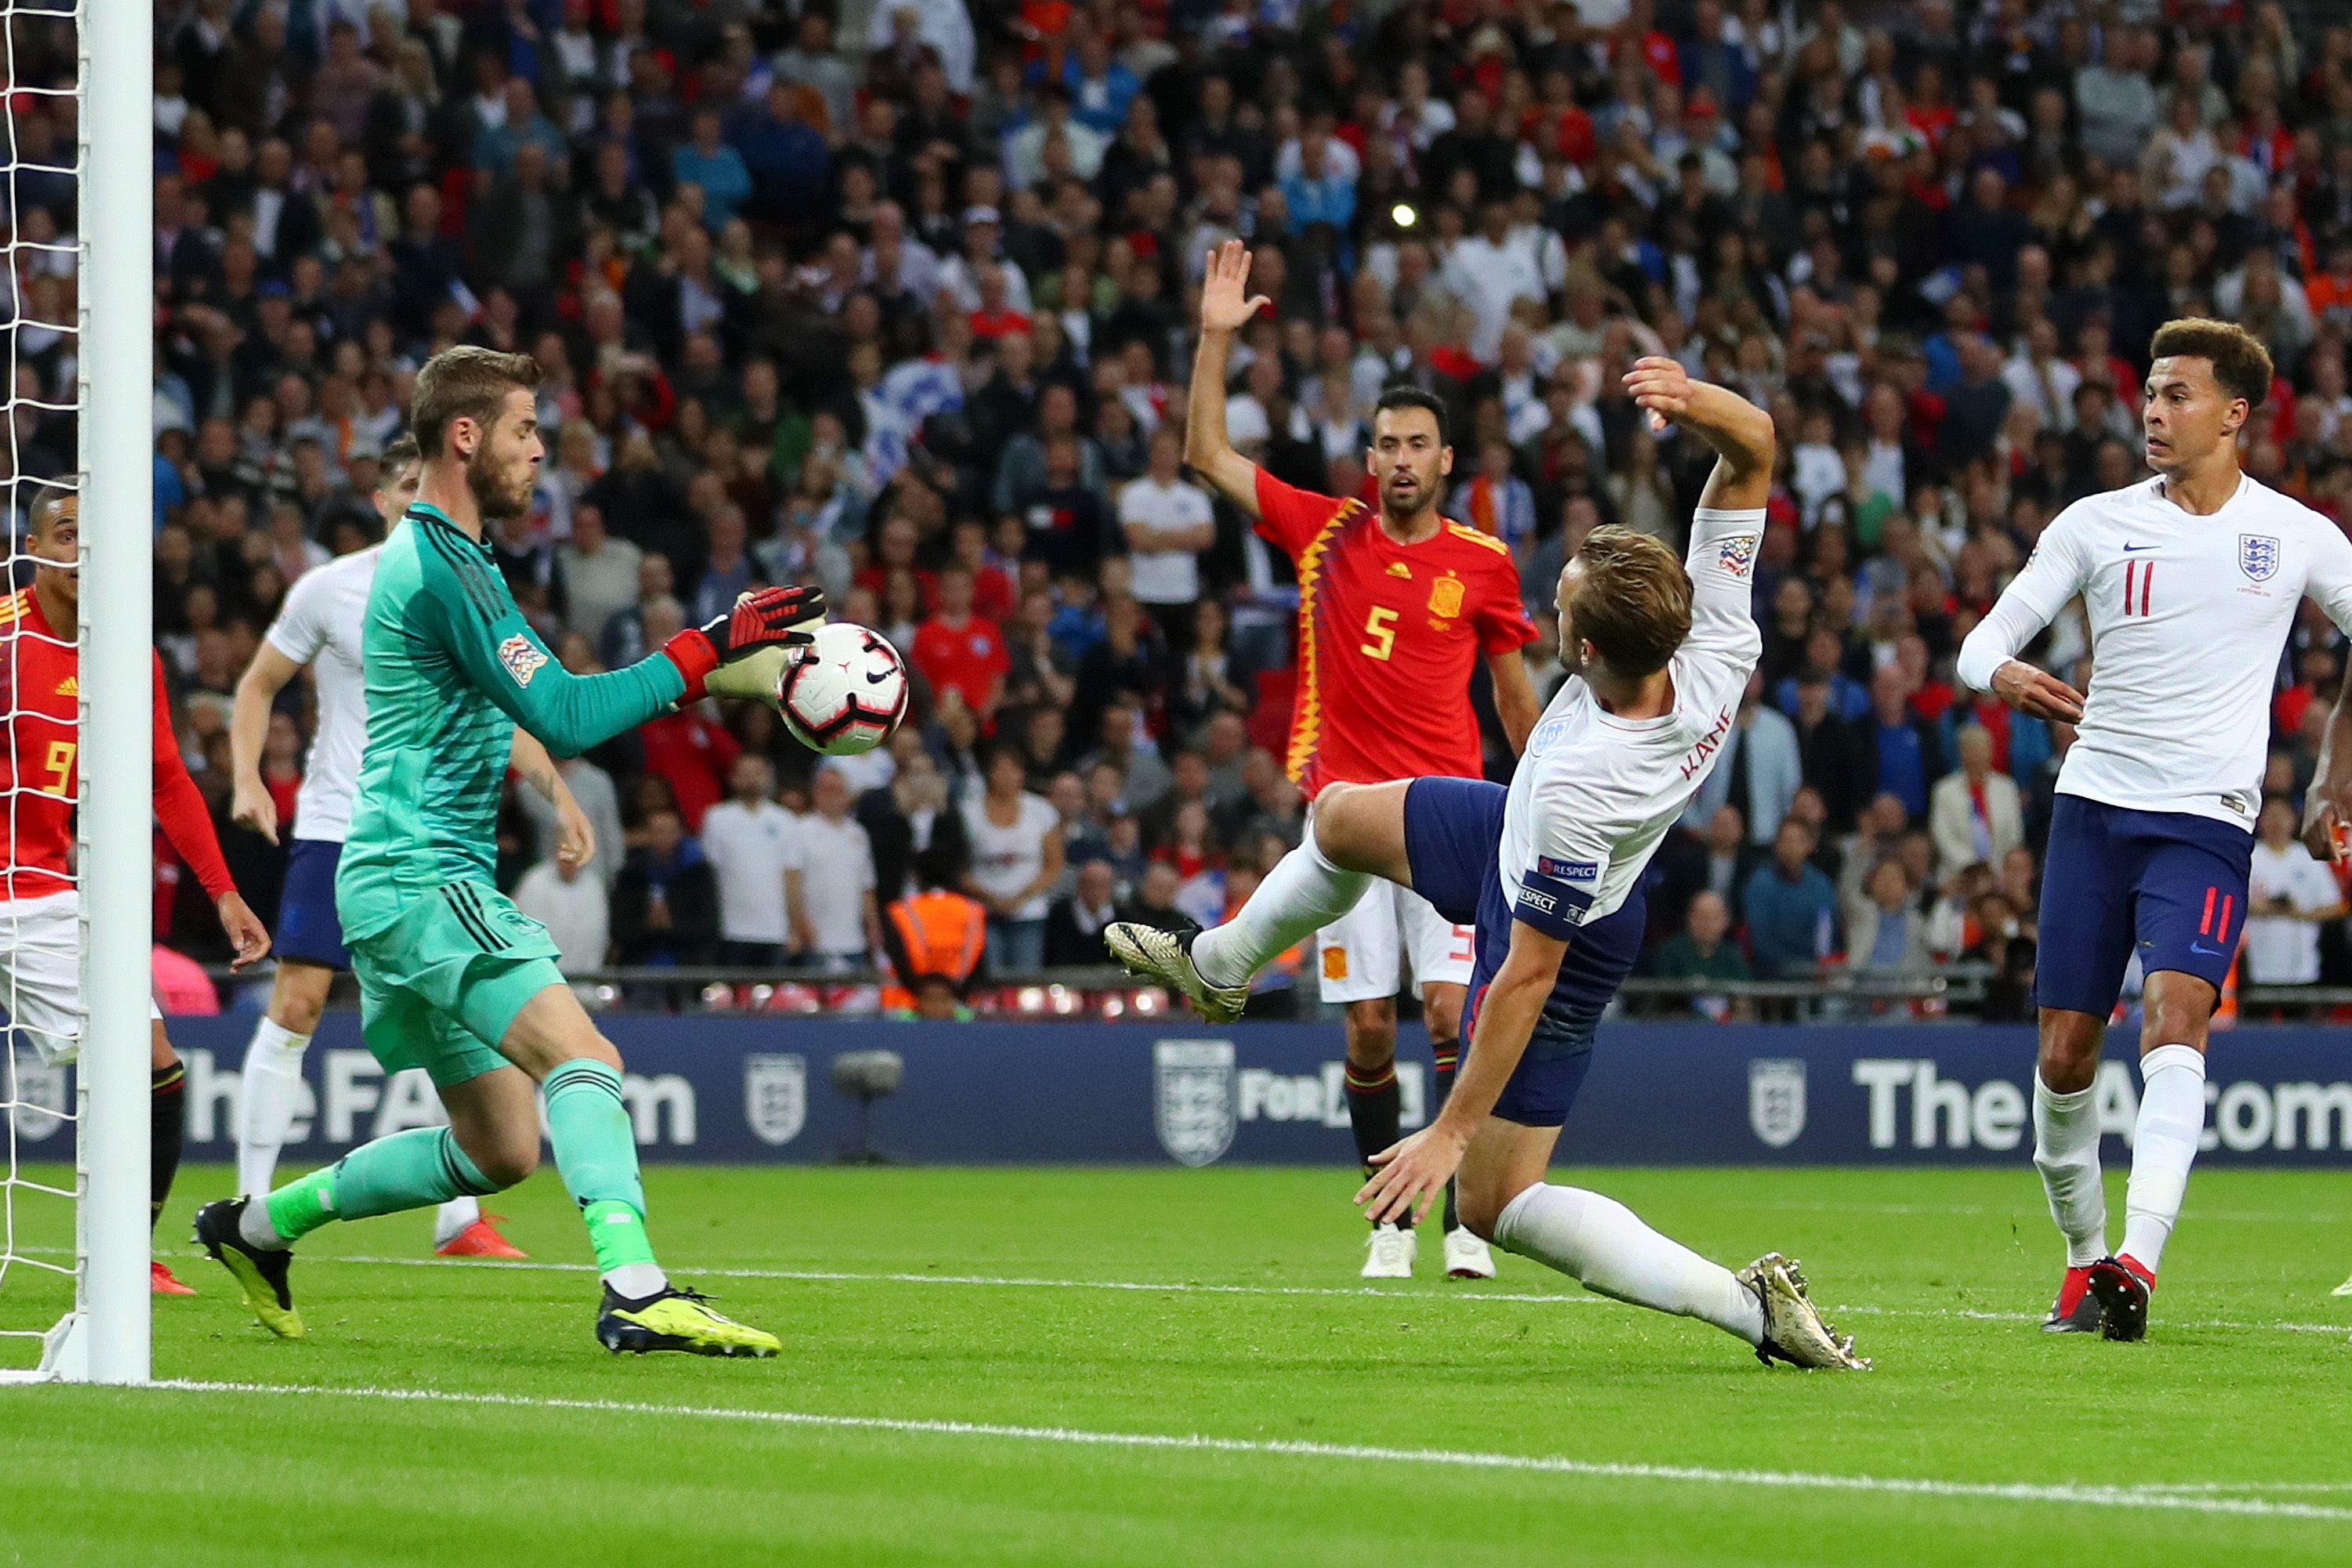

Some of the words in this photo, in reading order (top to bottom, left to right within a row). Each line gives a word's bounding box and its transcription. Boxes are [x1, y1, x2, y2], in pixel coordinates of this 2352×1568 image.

[2125, 559, 2154, 617] 11
[1359, 604, 1399, 661] 5
[42, 740, 77, 796] 9
[1553, 863, 1596, 877] RESPECT
[1519, 888, 1557, 911] ESPECT
[2198, 886, 2234, 944] 11
